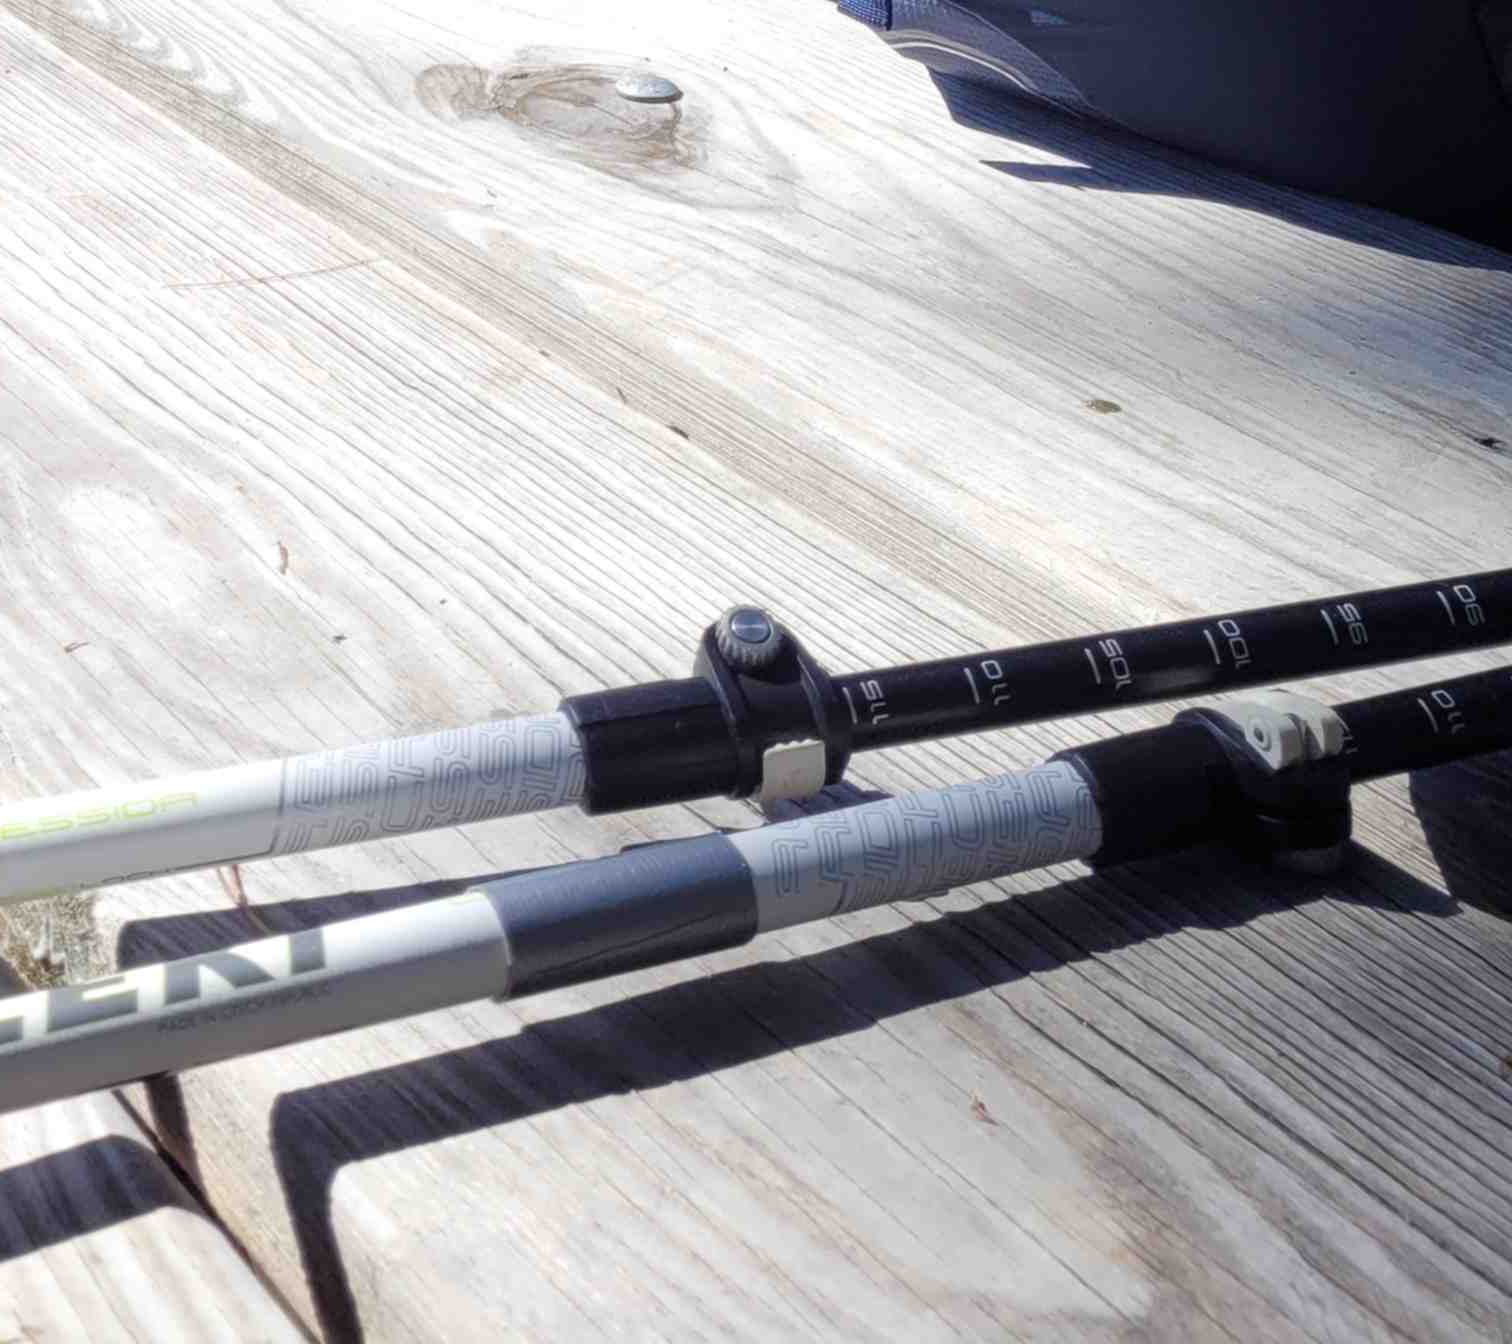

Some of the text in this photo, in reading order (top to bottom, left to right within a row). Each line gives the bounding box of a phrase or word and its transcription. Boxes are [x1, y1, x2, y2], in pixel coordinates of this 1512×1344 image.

[1098, 638, 1133, 690] 105
[1217, 619, 1252, 669] 100
[860, 679, 889, 725] 115
[981, 659, 1011, 706] 110
